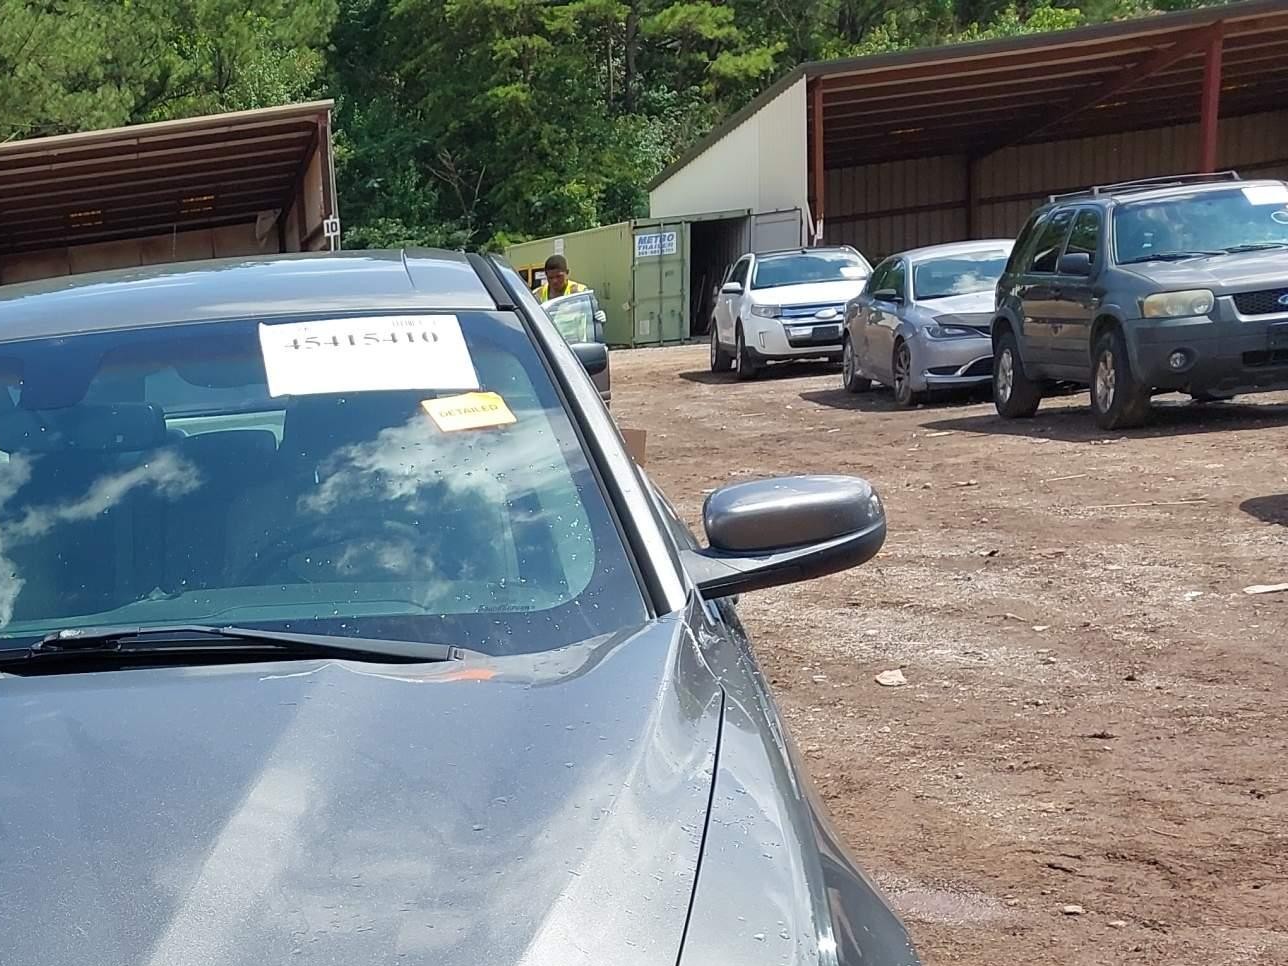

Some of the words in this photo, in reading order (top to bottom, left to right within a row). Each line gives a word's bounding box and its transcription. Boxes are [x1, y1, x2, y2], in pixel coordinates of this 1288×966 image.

[638, 233, 675, 245] METRO
[284, 330, 440, 350] 45415410
[439, 404, 499, 418] DETAILED
